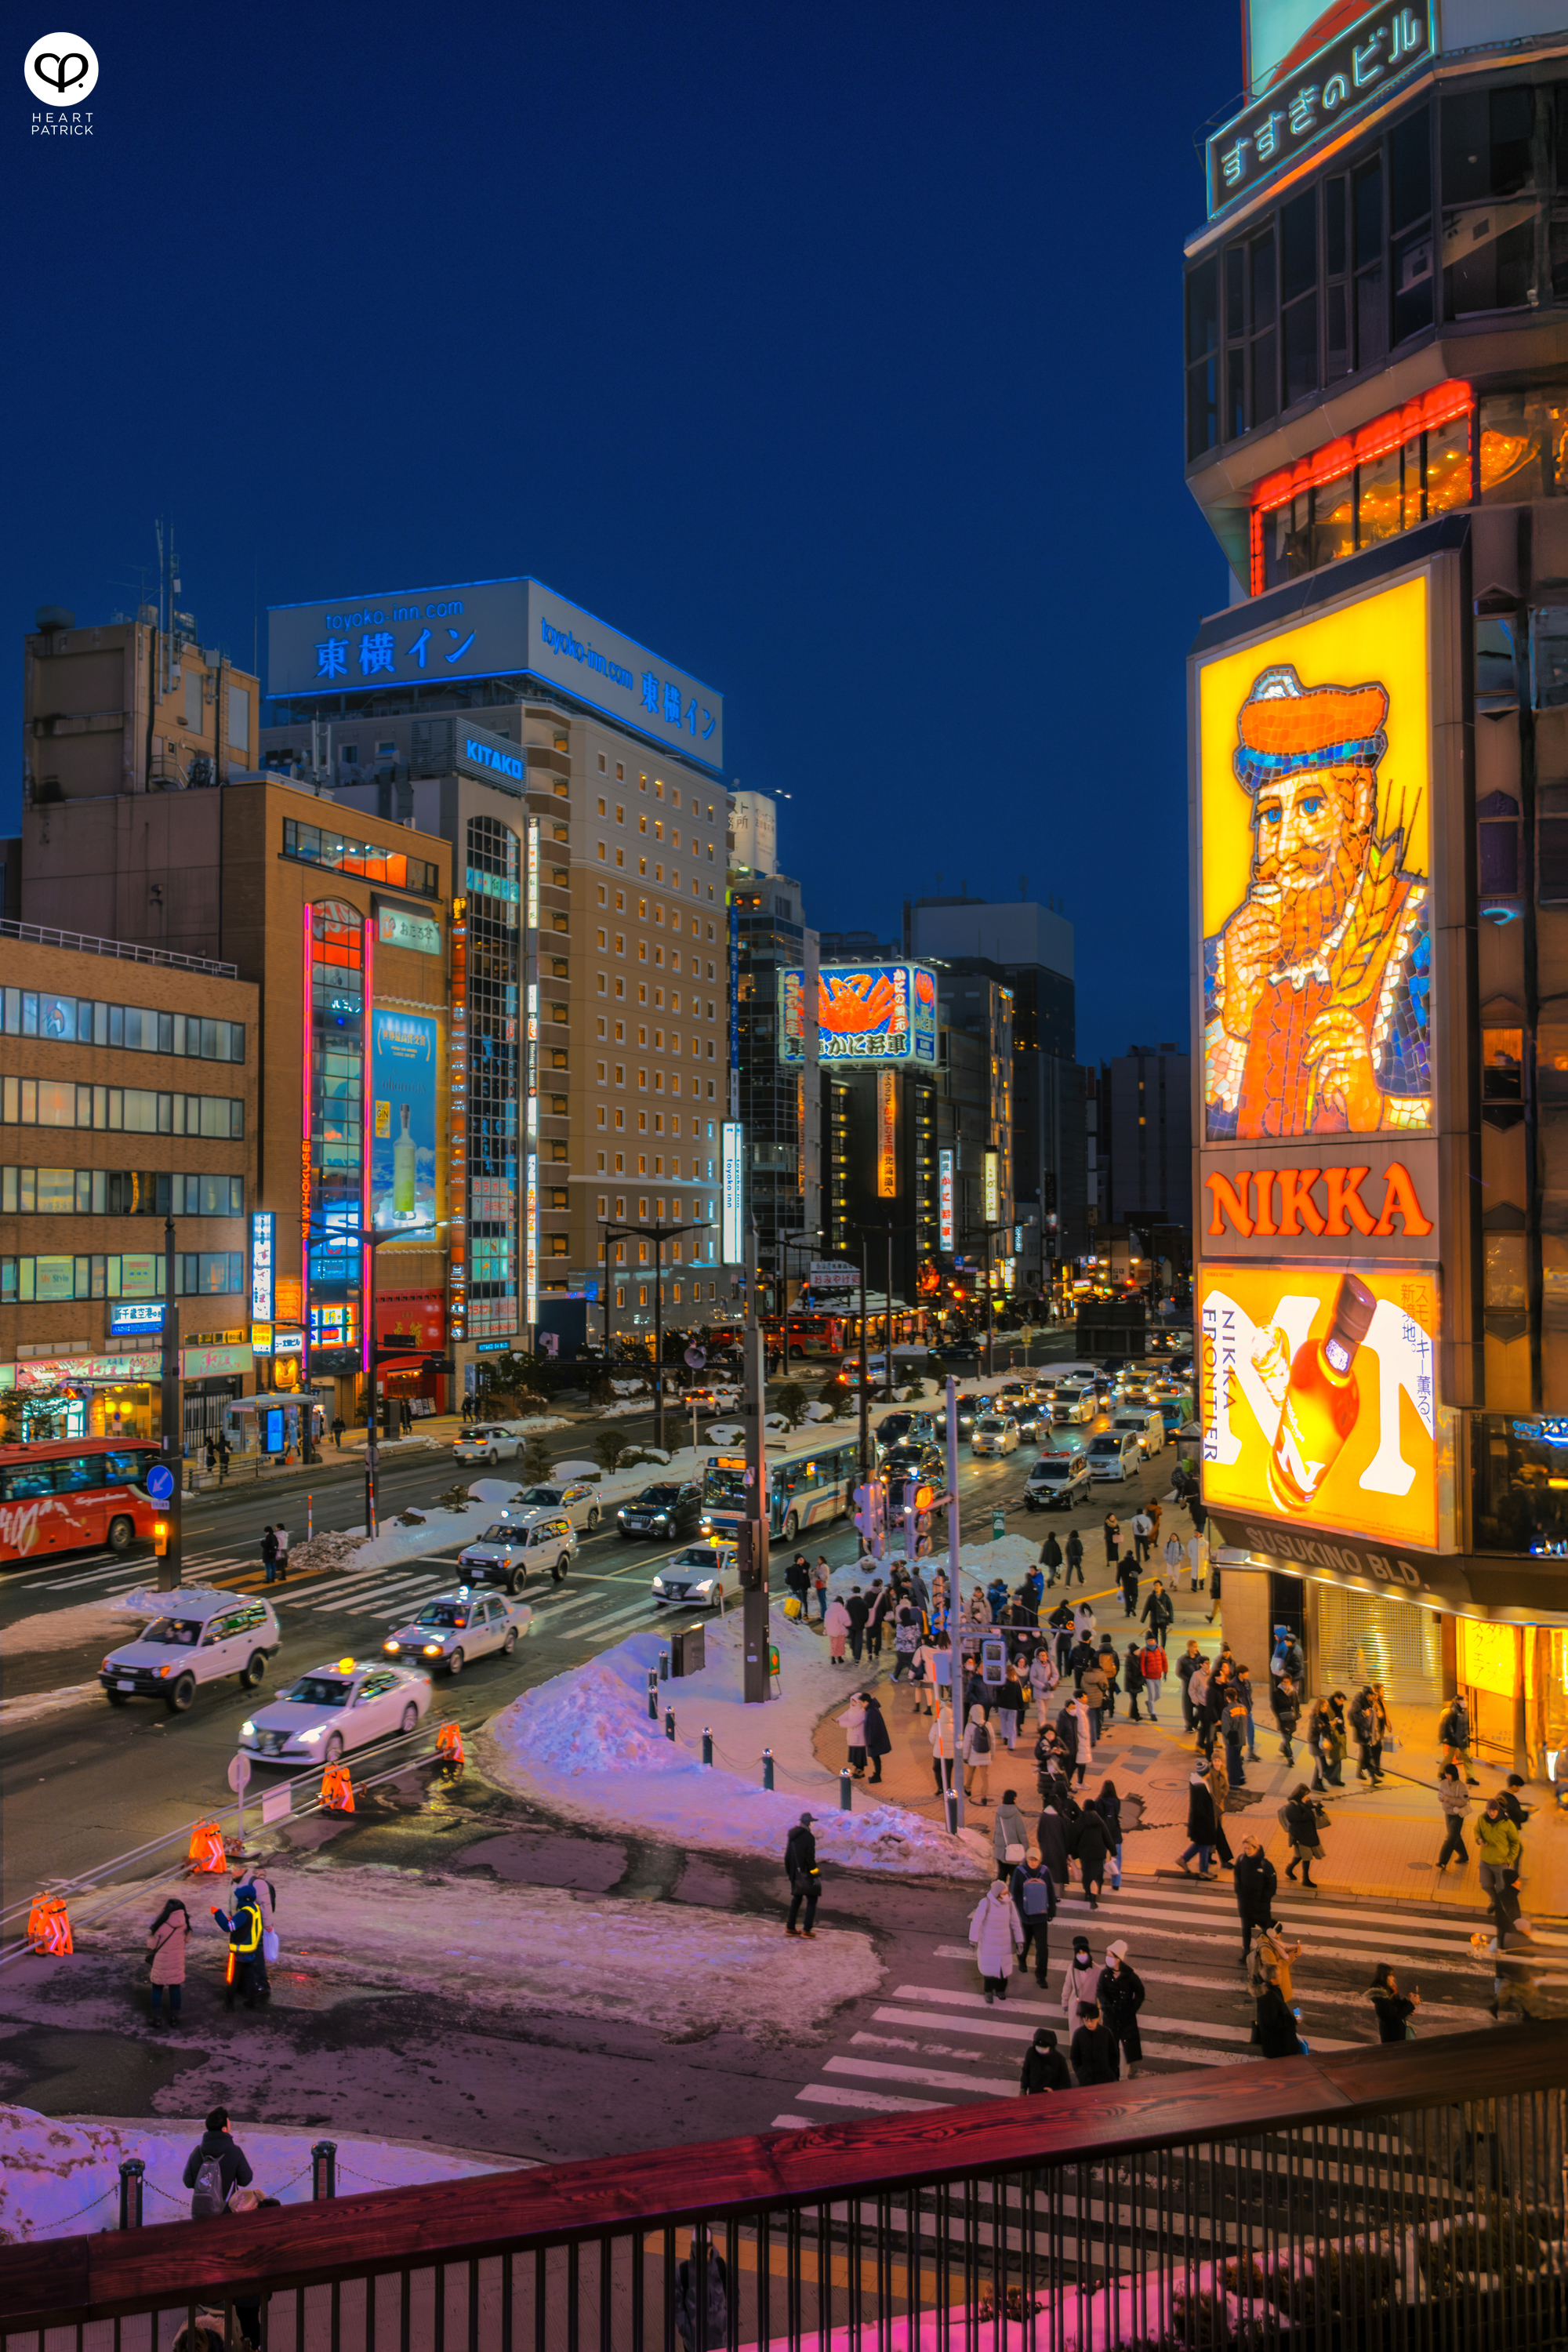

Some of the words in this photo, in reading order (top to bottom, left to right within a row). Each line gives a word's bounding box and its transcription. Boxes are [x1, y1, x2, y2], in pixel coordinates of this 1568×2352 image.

[1221, 7, 1422, 187] すすきのビル
[325, 599, 464, 633] toyoko-inn.com
[314, 628, 477, 680] 東横イン
[541, 616, 633, 691] toyoko-inn.com
[640, 670, 717, 741] 東横イン
[466, 739, 524, 781] KITAKO
[377, 1109, 389, 1119] GIN
[382, 1076, 410, 1092] ohoro
[411, 1082, 426, 1094] GIN
[301, 1140, 311, 1205] HOKUSEI
[1204, 1161, 1433, 1239] NIKKA
[301, 1207, 311, 1239] NEW
[1203, 1308, 1218, 1461] FRONTIER
[1221, 1309, 1236, 1410] NIKKA
[1245, 1526, 1363, 1573] SUSUKINO
[1366, 1553, 1431, 1591] BLD.
